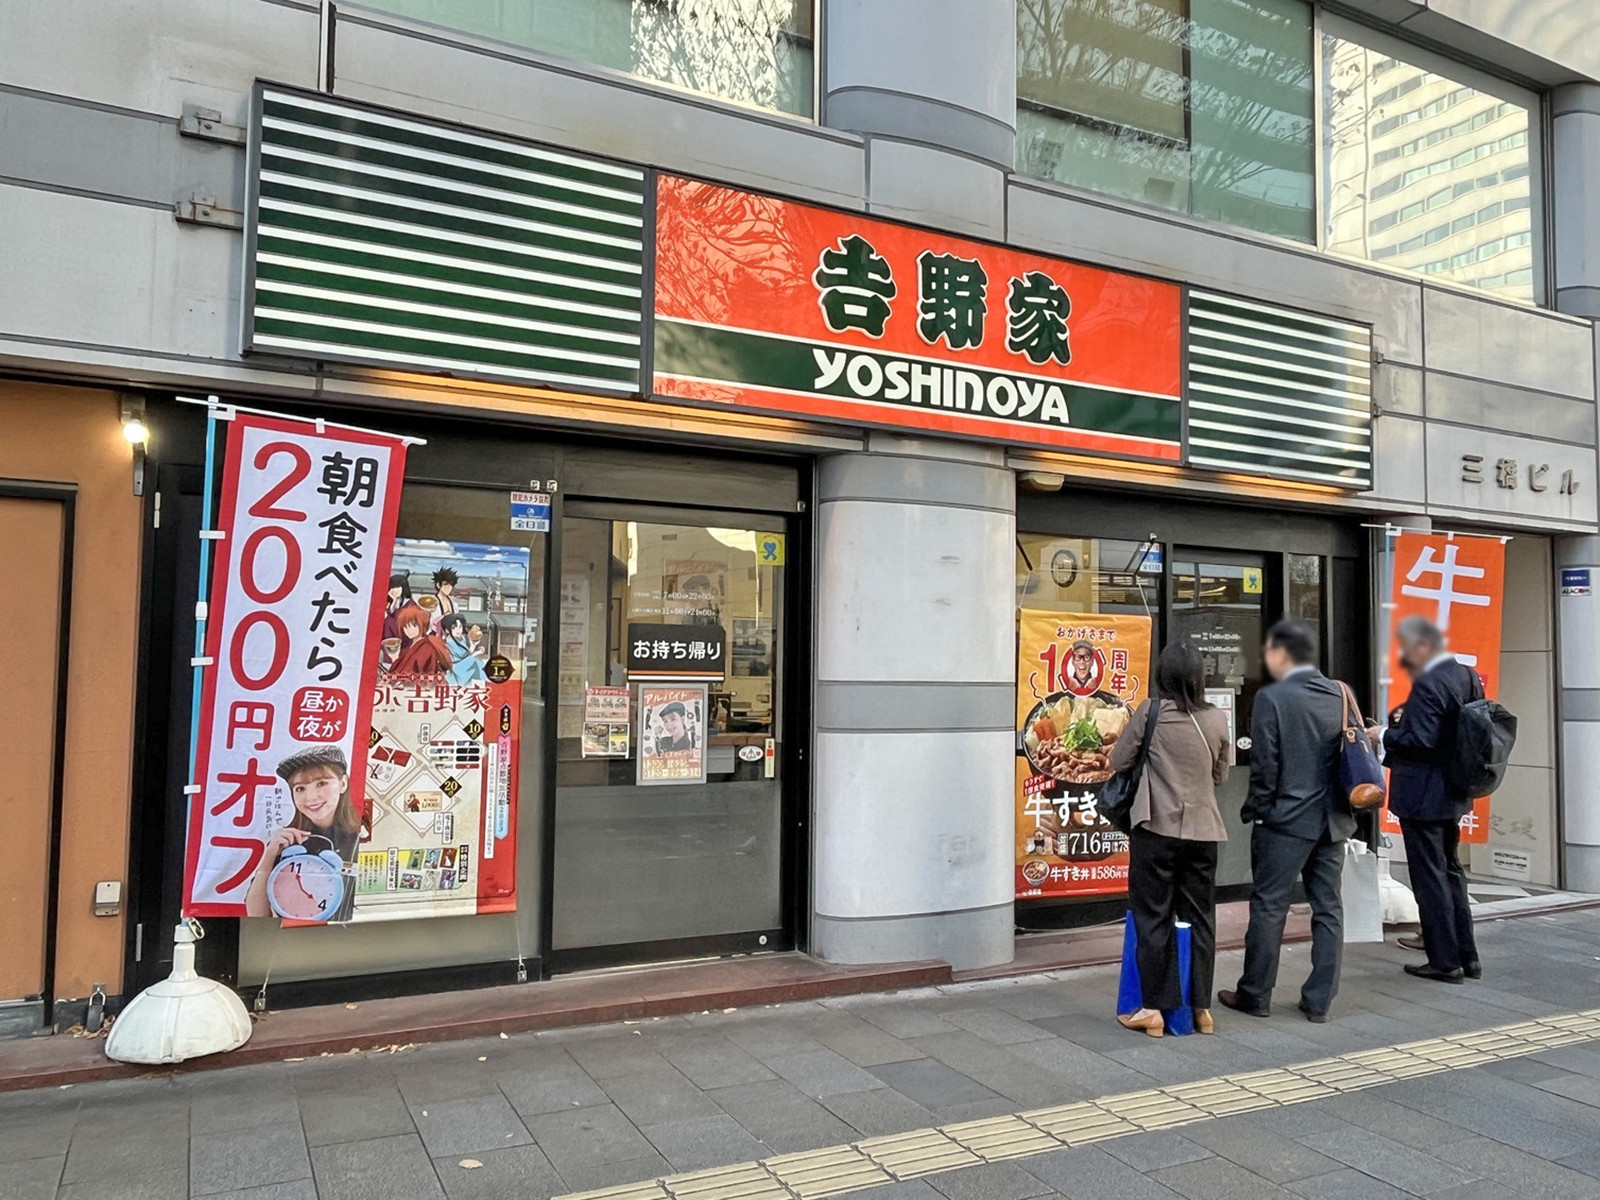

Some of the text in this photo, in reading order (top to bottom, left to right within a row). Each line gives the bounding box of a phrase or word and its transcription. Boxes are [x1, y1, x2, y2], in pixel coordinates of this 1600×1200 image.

[811, 234, 1073, 367] 吉野家
[812, 348, 1071, 424] YOSHINOYA
[306, 451, 379, 682] 朝食べたら
[633, 640, 721, 660] お持ち帰り
[300, 690, 343, 713] 昼か
[297, 715, 340, 738] 夜が
[1024, 791, 1111, 828] 牛すき
[289, 862, 302, 874] 11
[317, 899, 327, 911] 4
